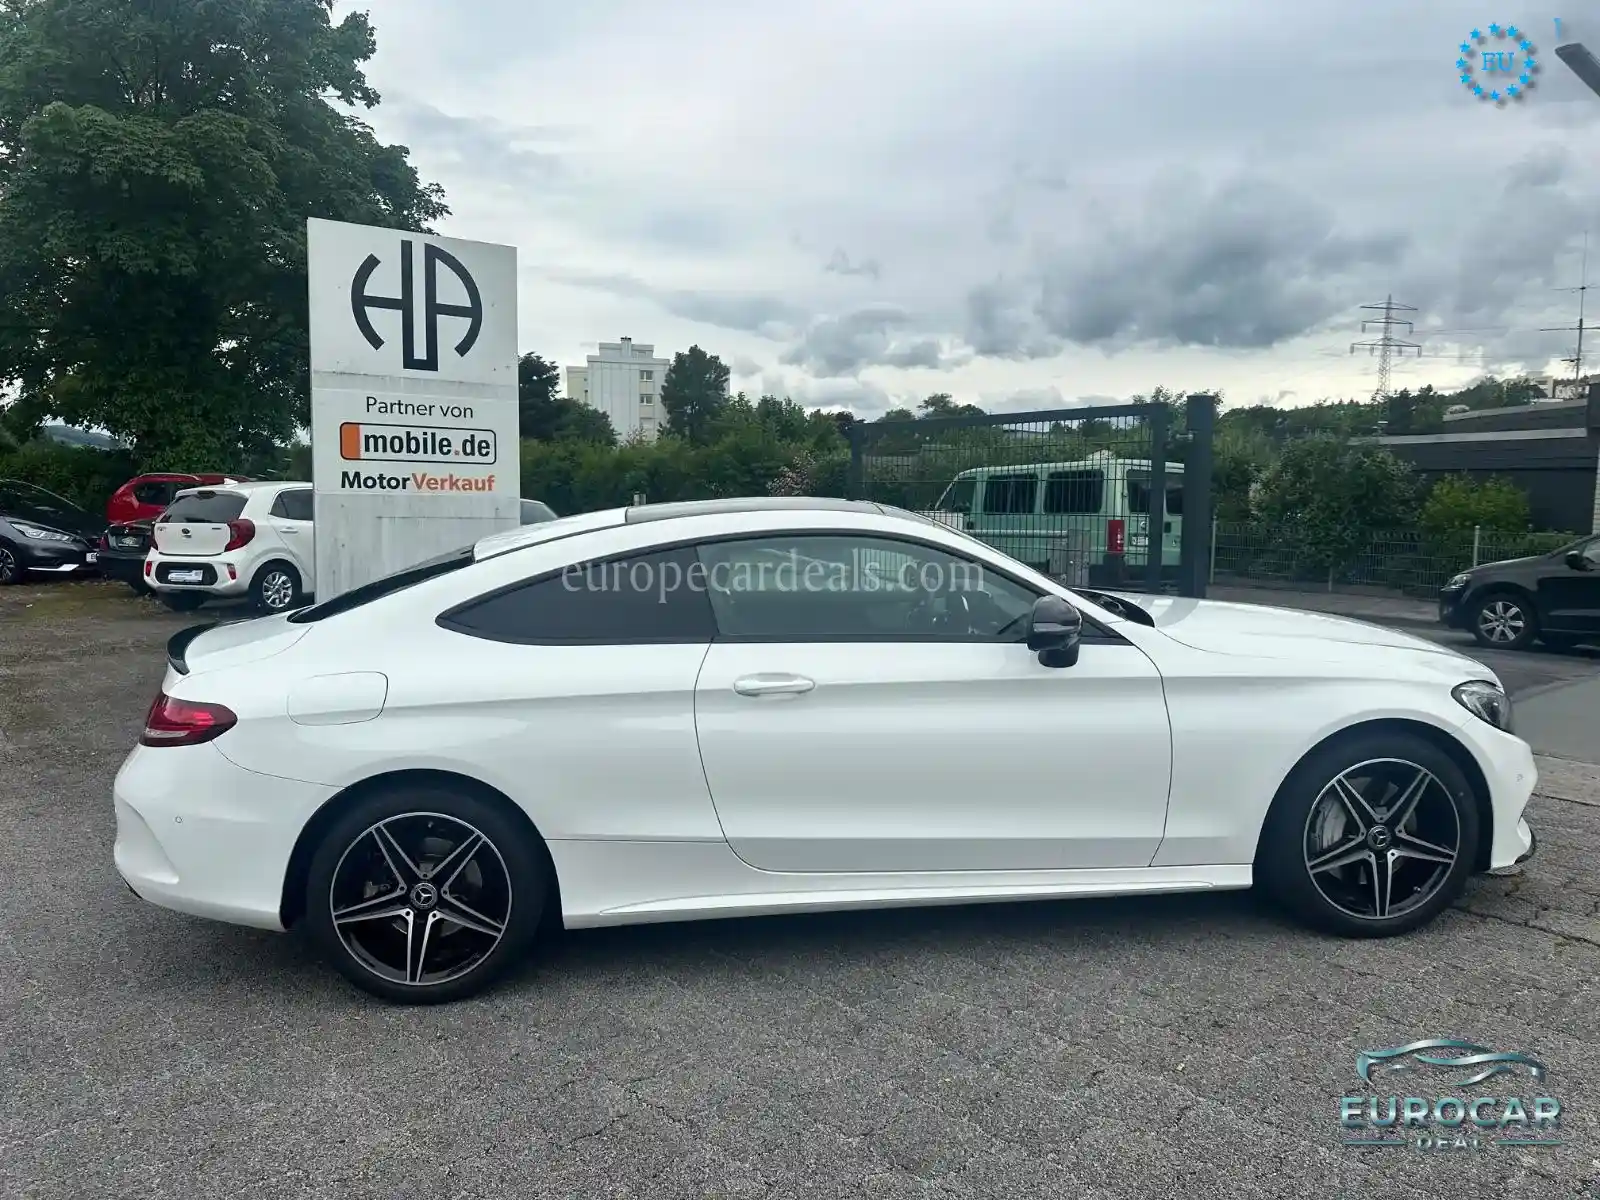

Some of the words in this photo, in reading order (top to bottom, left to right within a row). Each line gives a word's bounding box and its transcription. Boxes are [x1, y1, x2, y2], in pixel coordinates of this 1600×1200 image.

[366, 396, 435, 416] Partner
[439, 405, 474, 419] von
[364, 431, 491, 457] mobile.de
[341, 471, 496, 491] MotorVerkauf
